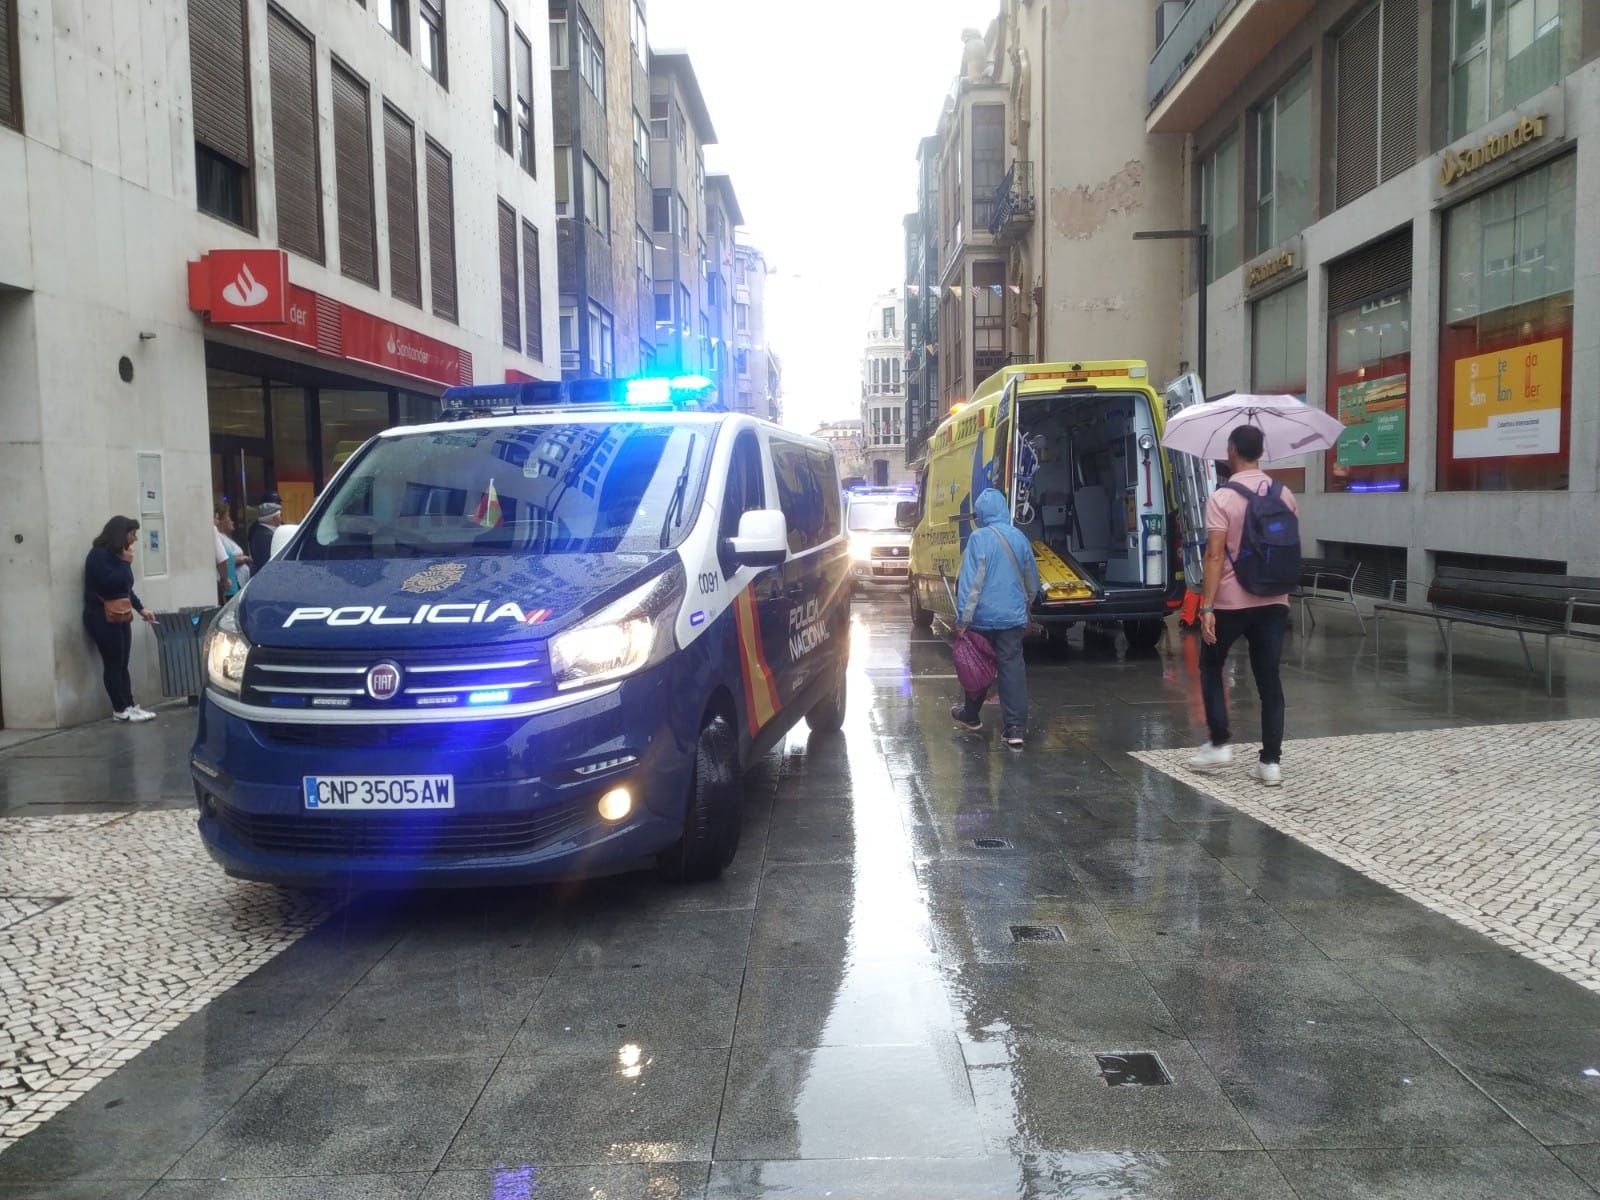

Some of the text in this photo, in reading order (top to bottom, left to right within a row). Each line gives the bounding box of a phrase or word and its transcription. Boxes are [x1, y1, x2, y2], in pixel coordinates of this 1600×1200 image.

[1457, 115, 1546, 177] Santander
[396, 340, 428, 364] Santander
[788, 619, 831, 664] NACIONAL
[373, 674, 393, 690] FIAT
